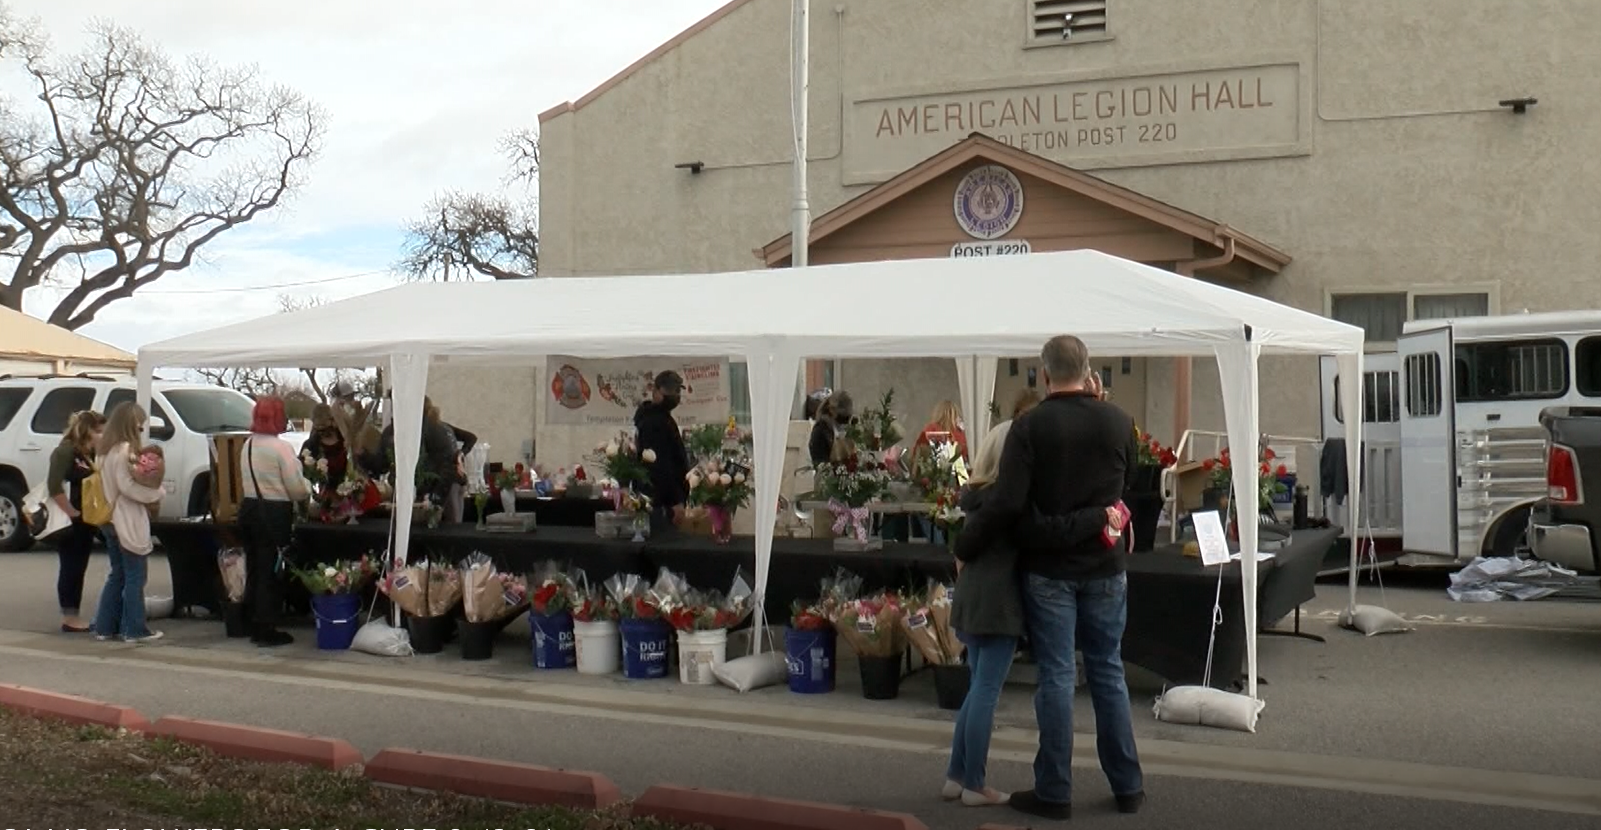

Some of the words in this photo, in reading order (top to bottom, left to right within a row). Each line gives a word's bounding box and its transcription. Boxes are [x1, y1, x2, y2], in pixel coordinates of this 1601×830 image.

[876, 97, 1041, 138] AMERICAN
[1052, 84, 1177, 123] LEGION
[1190, 77, 1273, 111] HALL
[958, 131, 1068, 151] PLETON
[1077, 125, 1127, 146] POST
[1139, 123, 1177, 142] 220
[954, 245, 992, 258] POST
[996, 244, 1028, 255] #220
[559, 631, 573, 641] DO
[640, 641, 656, 652] DO
